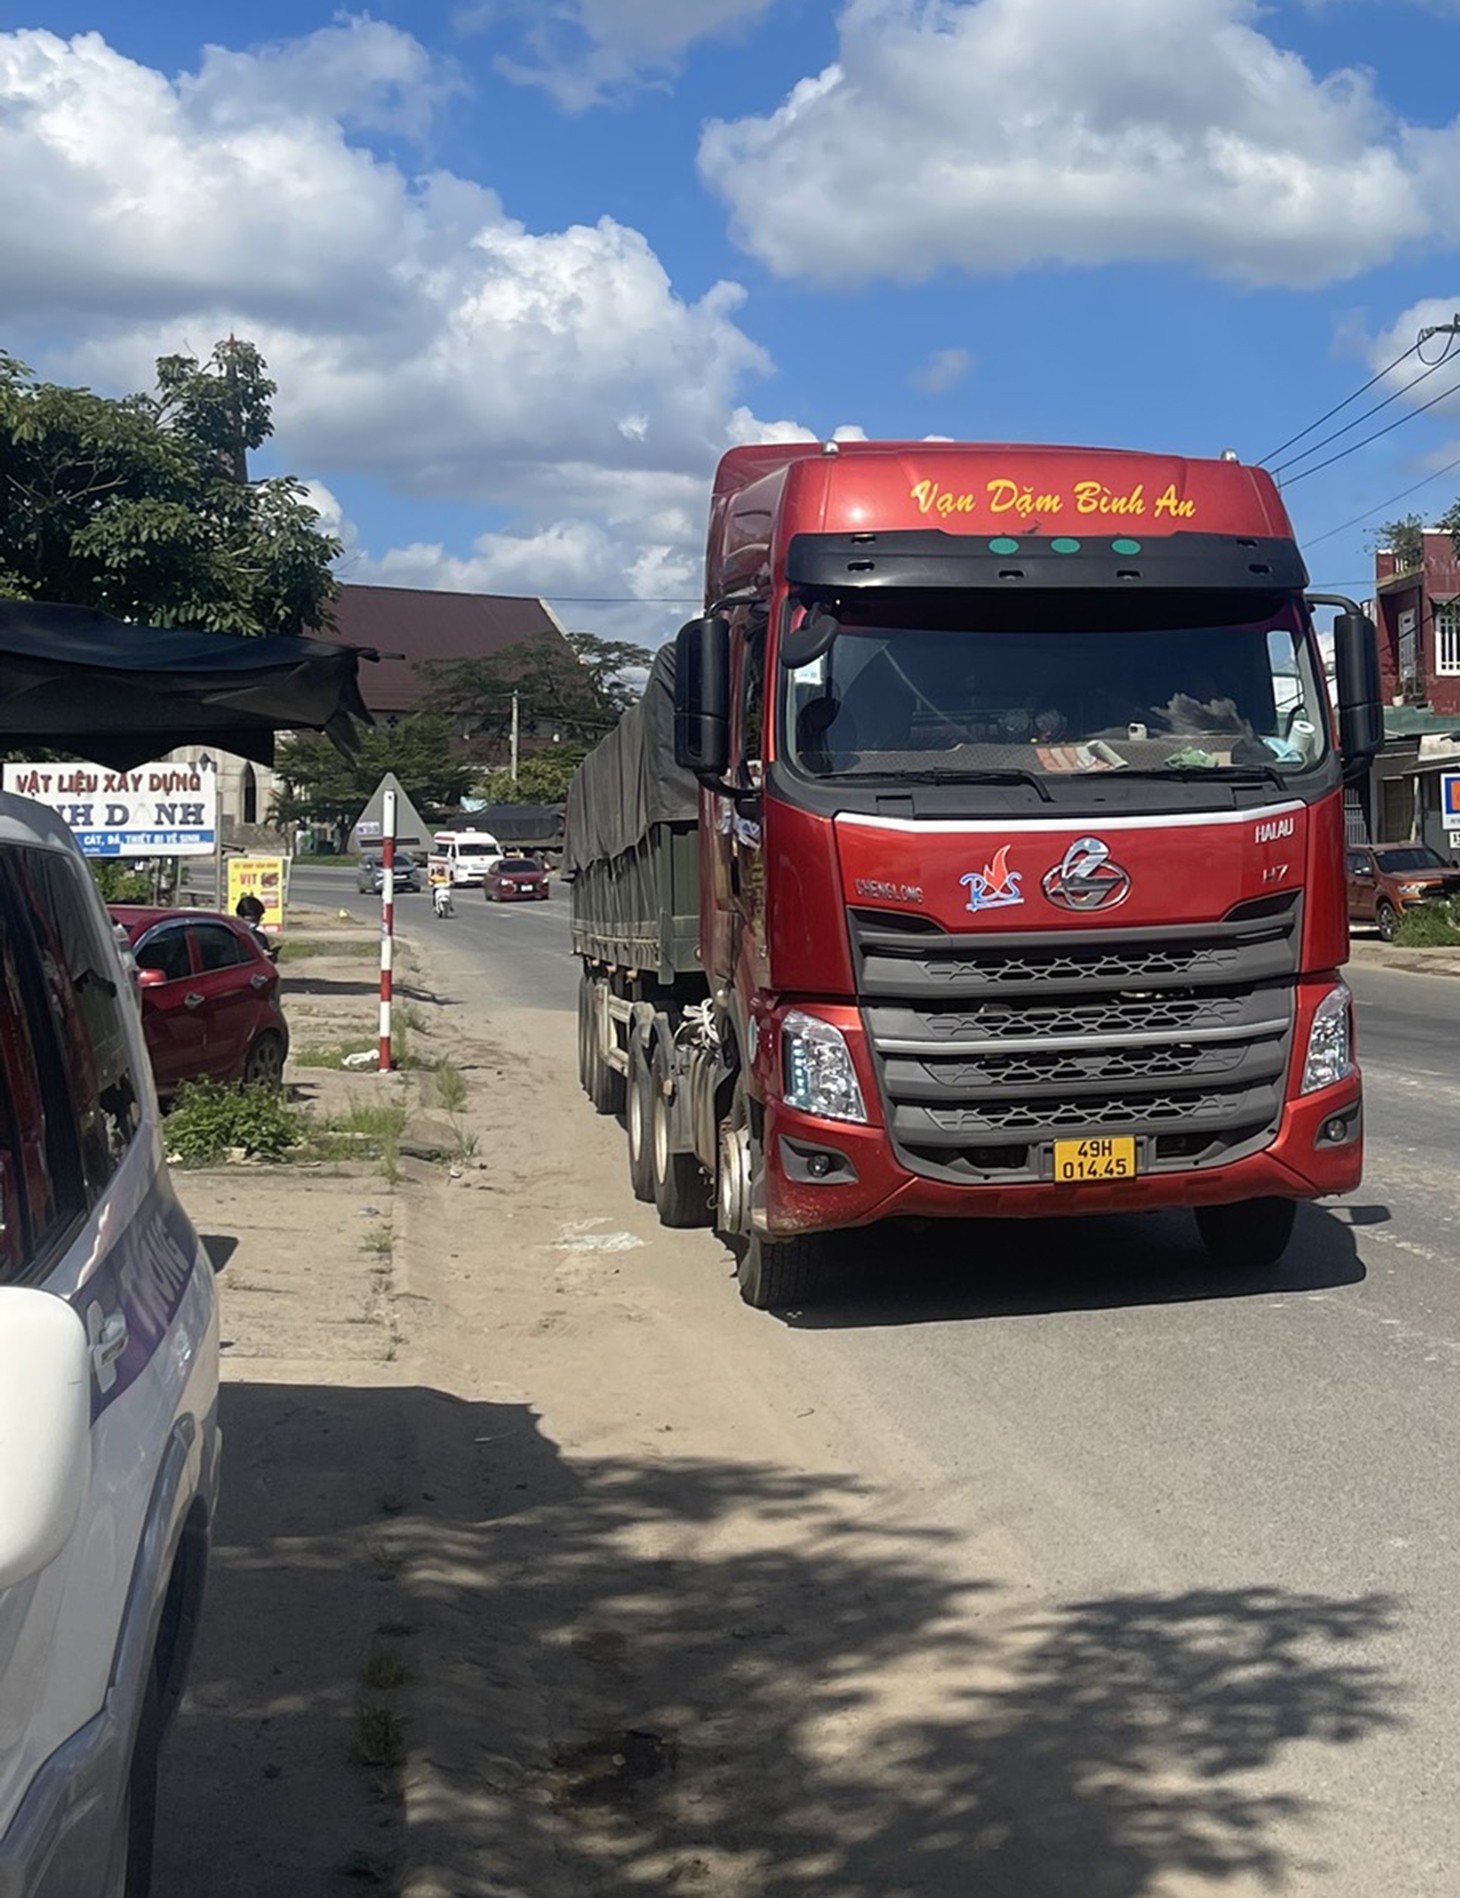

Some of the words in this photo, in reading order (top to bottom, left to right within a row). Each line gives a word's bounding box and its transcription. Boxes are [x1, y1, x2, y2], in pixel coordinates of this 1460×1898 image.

[911, 479, 976, 518] Vạn
[987, 479, 1063, 518] Dặm
[1074, 481, 1146, 516] Bình
[1154, 484, 1196, 518] An
[16, 770, 51, 796] VẬT
[58, 770, 98, 796] LIỆU
[149, 771, 201, 796] DỰNG
[855, 878, 925, 905] CHENGLONG
[1077, 1141, 1112, 1158] 49H
[1063, 1158, 1126, 1179] 014.45
